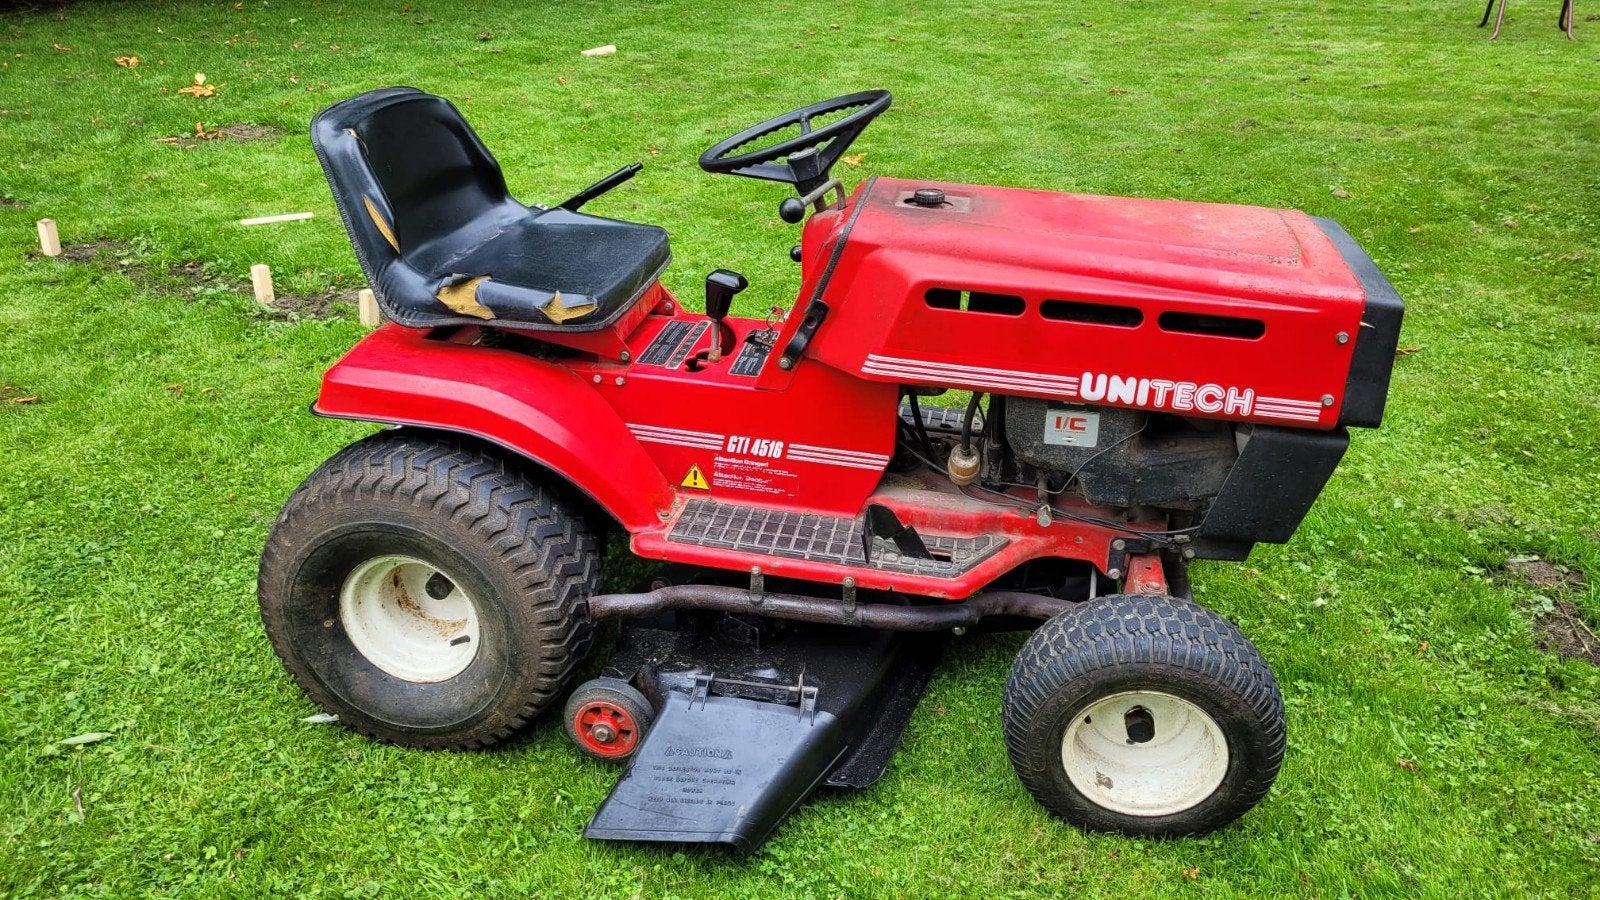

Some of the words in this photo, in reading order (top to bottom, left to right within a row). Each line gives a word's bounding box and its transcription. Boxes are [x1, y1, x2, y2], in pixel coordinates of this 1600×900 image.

[1080, 372, 1254, 416] UNITECH
[1055, 416, 1087, 431] I/C
[727, 435, 750, 454] GTI
[750, 439, 784, 458] 4516
[675, 747, 723, 759] CAUTION
